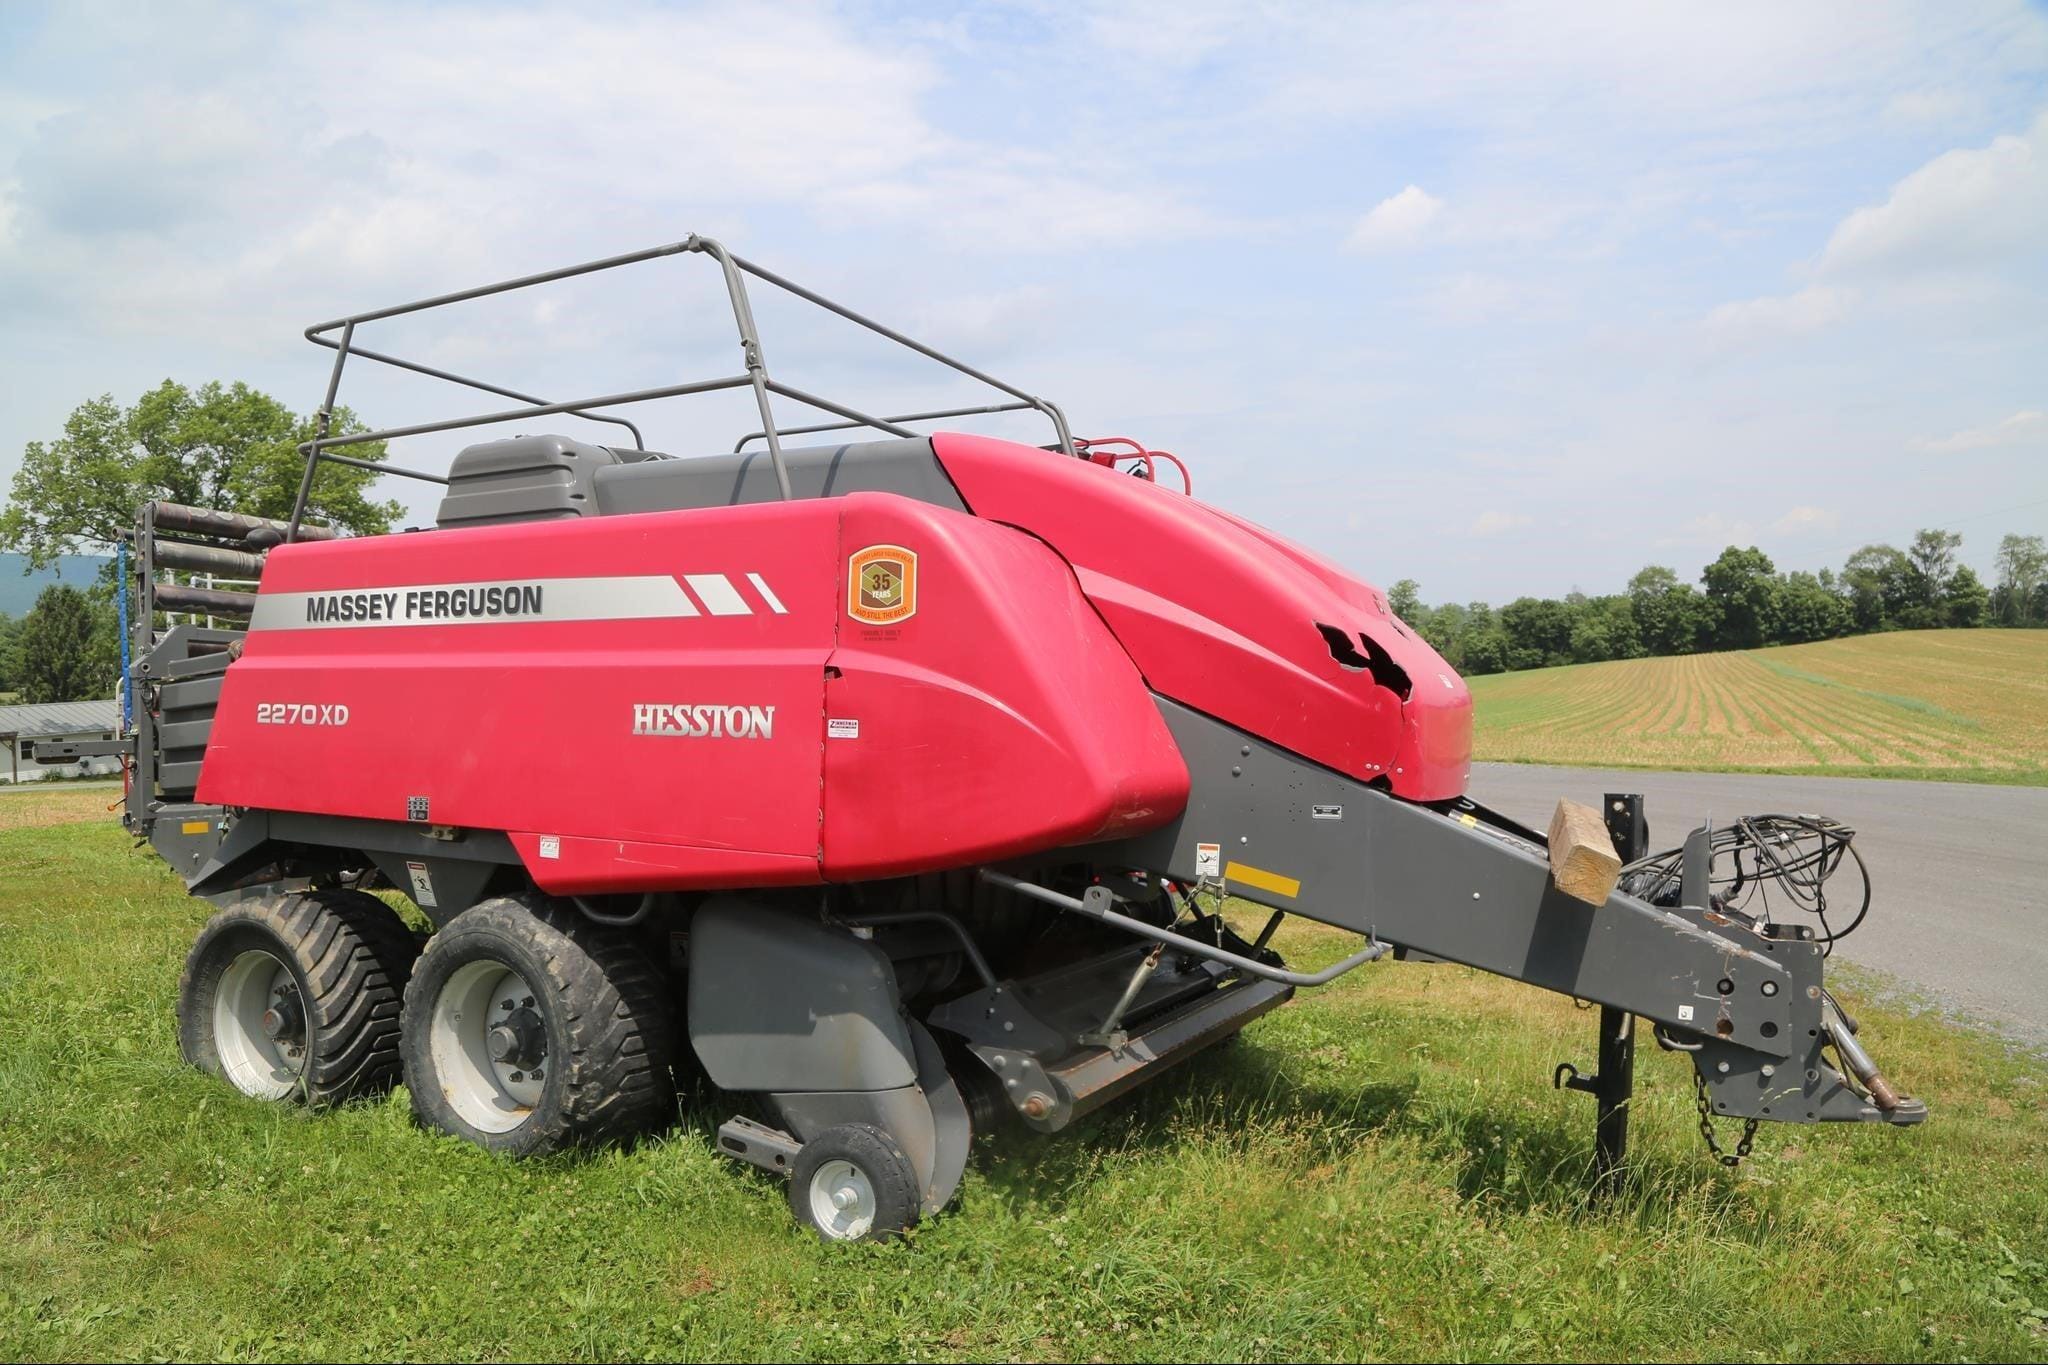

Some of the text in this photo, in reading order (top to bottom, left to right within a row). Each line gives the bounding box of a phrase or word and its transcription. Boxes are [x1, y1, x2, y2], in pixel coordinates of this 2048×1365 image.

[872, 574, 890, 590] 35
[872, 590, 891, 599] YEARS
[306, 585, 543, 622] MASSEY FERGUSON
[632, 704, 776, 739] HESSTON
